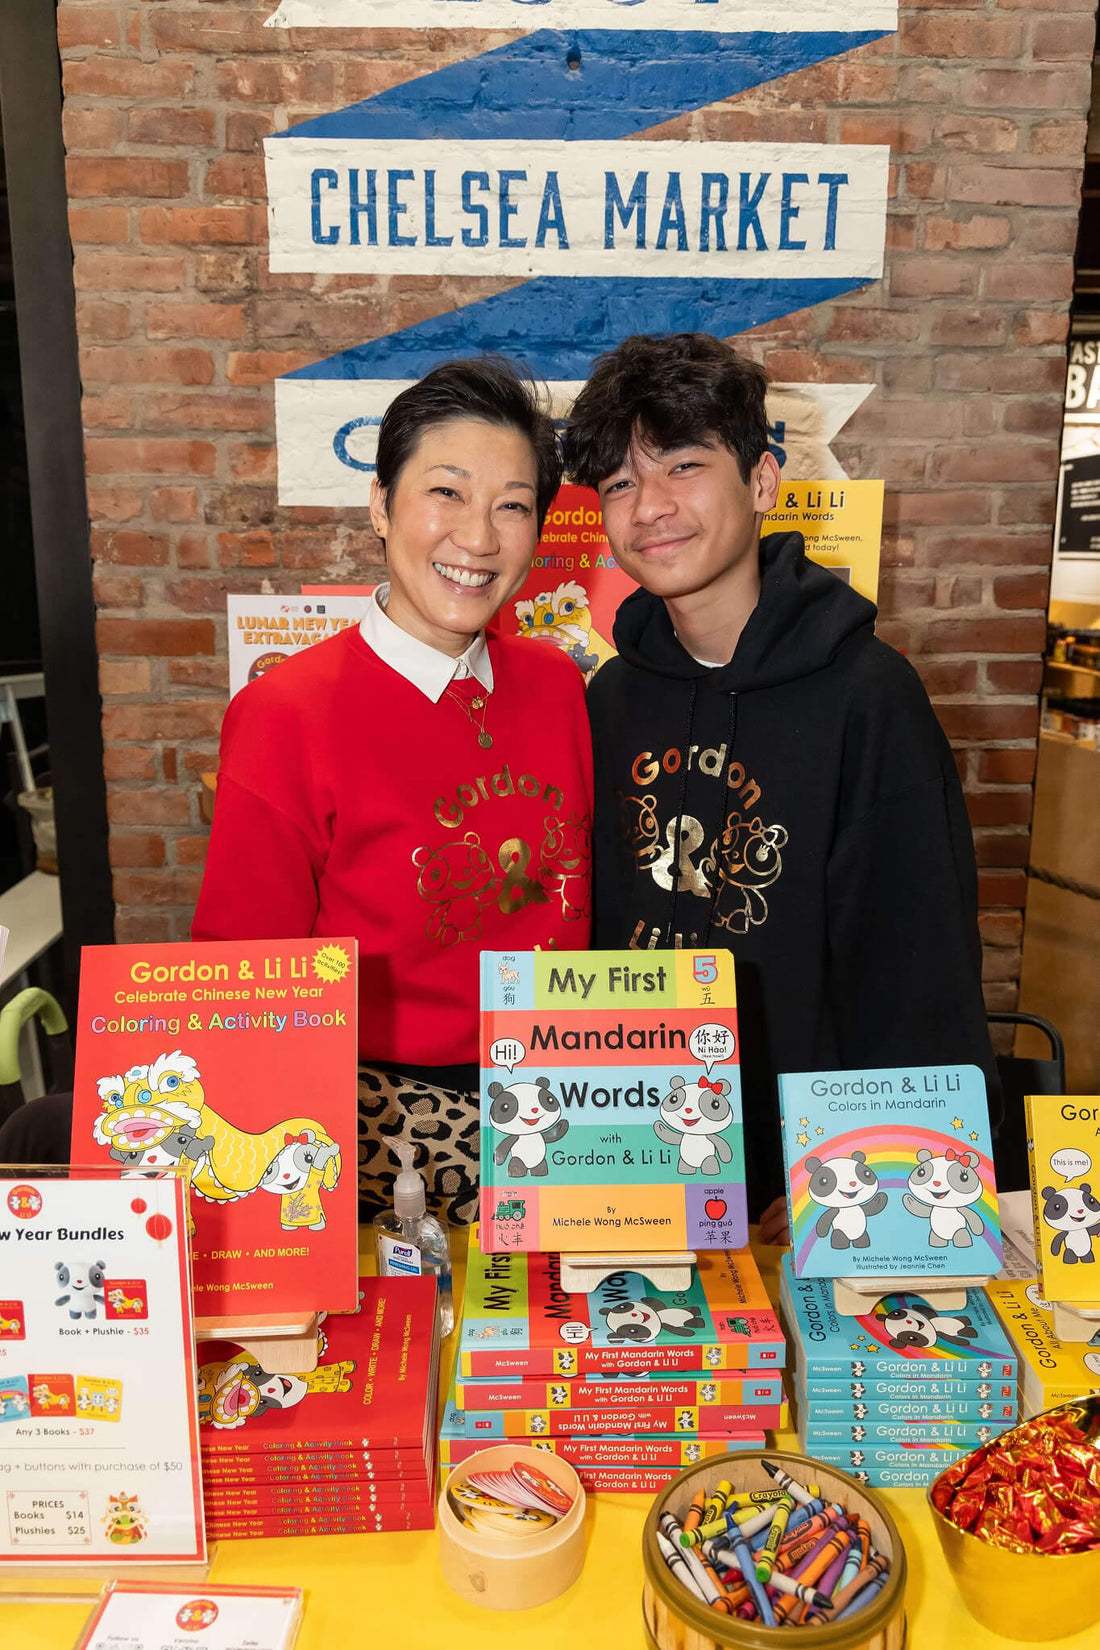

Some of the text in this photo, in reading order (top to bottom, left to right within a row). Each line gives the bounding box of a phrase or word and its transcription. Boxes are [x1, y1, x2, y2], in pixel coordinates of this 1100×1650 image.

[310, 168, 848, 252] CHELSEA MARKET
[785, 491, 844, 508] & Li Li
[761, 511, 834, 521] ndarin Words
[541, 532, 578, 543] ebrate
[579, 553, 590, 568] &
[237, 615, 290, 630] LUNAR
[292, 617, 327, 631] NEW
[632, 743, 762, 810] Gordon
[433, 764, 564, 829] Gordon
[651, 814, 714, 899] &
[498, 837, 552, 915] &
[502, 955, 516, 963] dog
[130, 956, 307, 983] Gordon & Li Li
[693, 955, 719, 985] 5
[548, 966, 667, 999] My First
[114, 985, 323, 1004] Celebrate Chinese New Year
[699, 992, 716, 1006] 五
[91, 1008, 347, 1036] Coloring & Activity Book
[530, 1023, 687, 1051] Mandarin
[694, 1028, 730, 1045] 你好
[495, 1044, 517, 1061] Hi!
[811, 1074, 961, 1097] Gordon & Li Li
[560, 1081, 660, 1109] Words
[828, 1097, 946, 1113] Colors in Mandarin
[600, 1132, 622, 1144] with
[552, 1149, 671, 1166] Gordon & Li Li
[1053, 1158, 1089, 1166] This is me!
[704, 1187, 724, 1196] apple
[606, 1206, 616, 1215] By
[552, 1216, 672, 1228] Michele Wong McSween
[15, 1228, 52, 1241] Year
[57, 1227, 124, 1241] Bundles
[211, 1247, 310, 1260] DRAW AND MORE!
[852, 1254, 948, 1264] By Michele Wong McSween
[889, 1263, 898, 1271] by
[926, 1262, 947, 1270] Chen
[206, 1283, 230, 1292] Wong
[232, 1281, 274, 1291] McSween
[483, 1285, 517, 1310] My
[797, 1284, 826, 1341] Gordon &
[827, 1310, 840, 1333] Colors
[59, 1327, 149, 1336] Book Plushie $35
[566, 1325, 584, 1340] Hi!
[1021, 1324, 1057, 1369] Gordon
[585, 1350, 694, 1360] My First Mandarin Words
[617, 1359, 651, 1368] Gordon
[653, 1359, 660, 1367] &
[672, 1358, 679, 1366] Li
[876, 1361, 927, 1373] Gordon
[931, 1361, 942, 1373] &
[944, 1361, 954, 1373] Li
[958, 1361, 967, 1373] Li
[15, 1428, 95, 1437] Any 3 Books $37
[558, 1421, 667, 1431] My First Mandarin Words
[24, 1461, 183, 1474] buttons with purchase of $50
[752, 1489, 788, 1500] Crayola
[32, 1500, 65, 1509] PRICES
[14, 1511, 84, 1520] Books $14
[15, 1526, 86, 1535] Plushies $25
